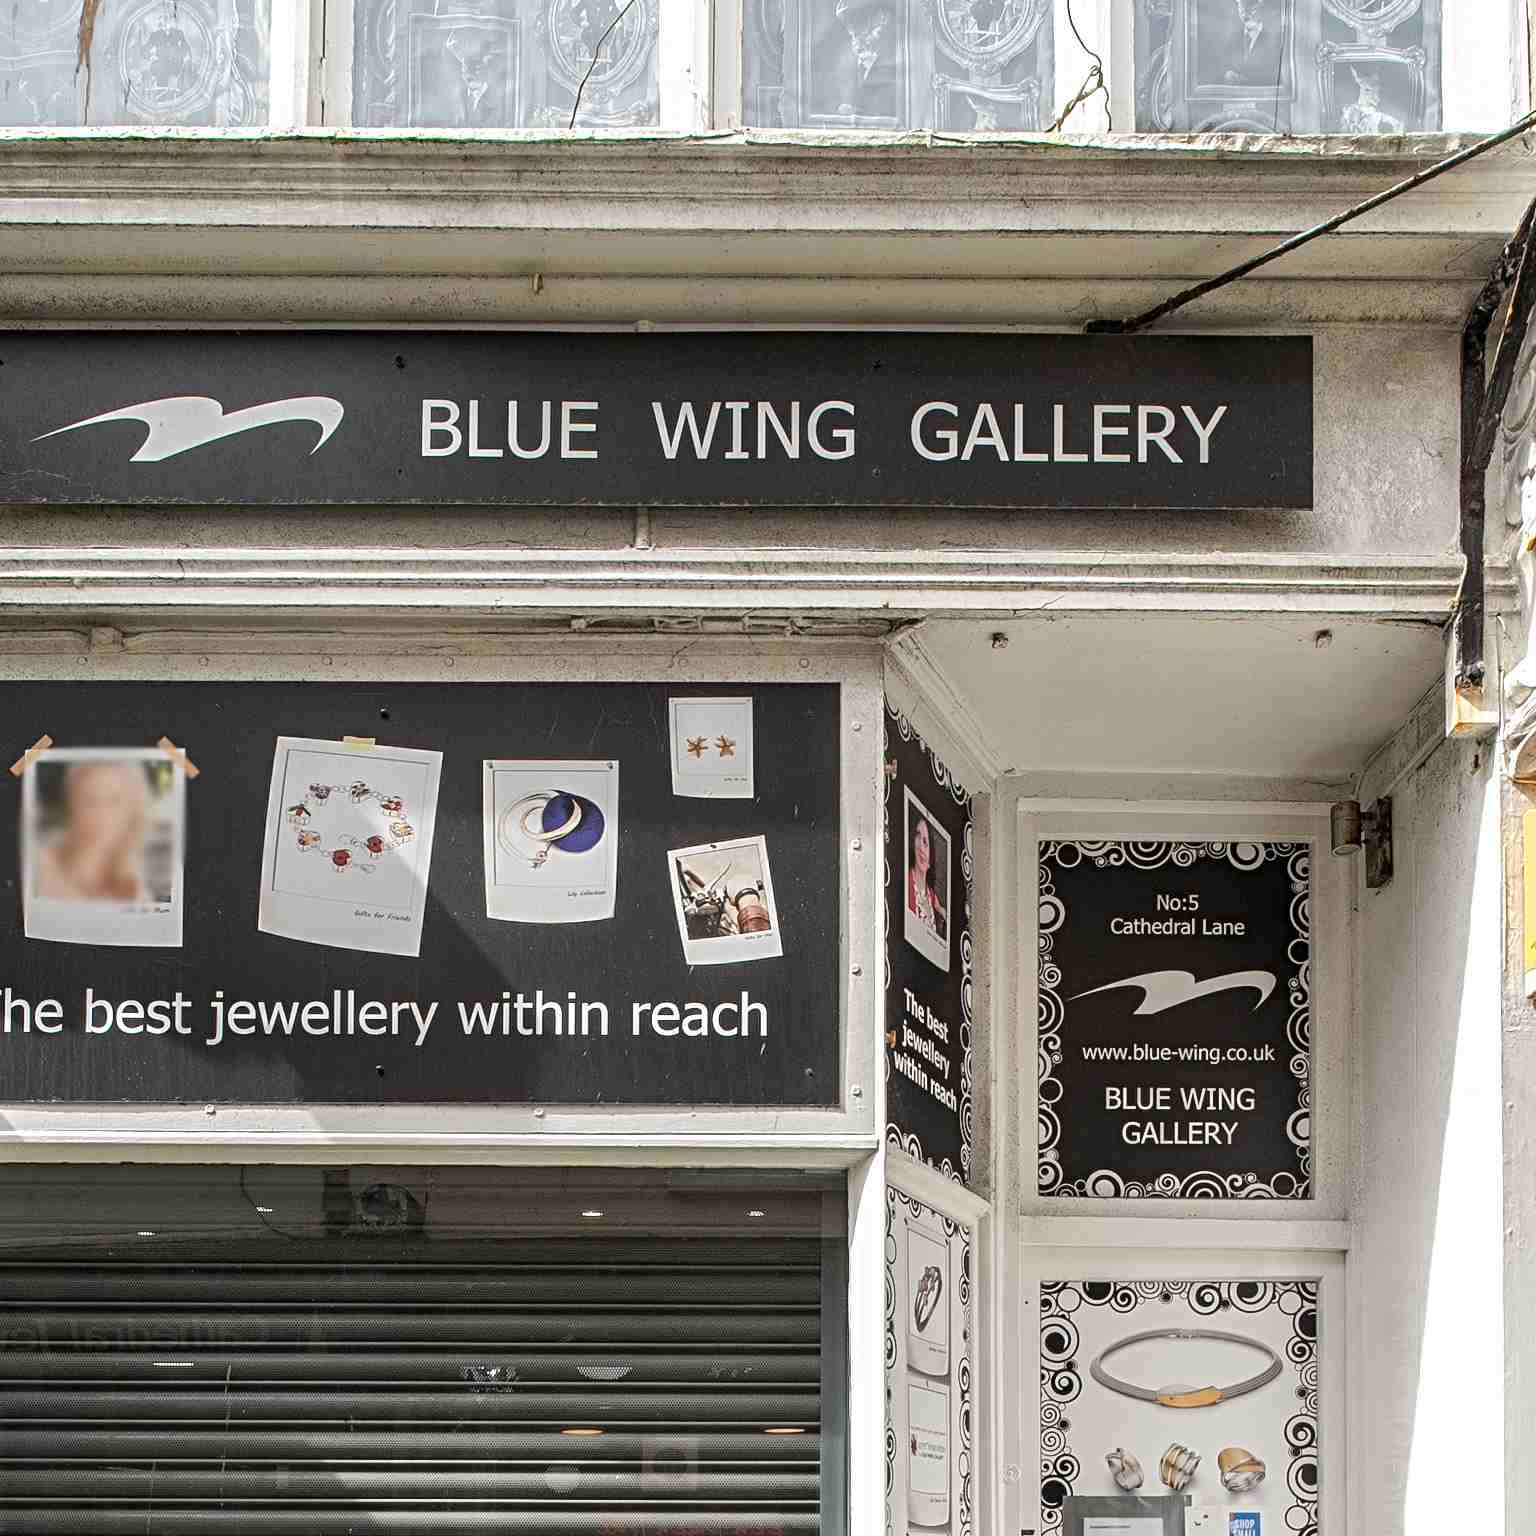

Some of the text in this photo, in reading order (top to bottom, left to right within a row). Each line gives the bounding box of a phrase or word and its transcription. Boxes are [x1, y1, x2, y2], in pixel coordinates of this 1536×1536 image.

[420, 398, 1227, 465] BLUE WING GALLERY
[1156, 894, 1200, 912] No:5
[1110, 918, 1246, 936] Cathedral Lane
[84, 989, 192, 1034] best
[206, 990, 439, 1045] jewellery
[458, 991, 610, 1036] within
[631, 992, 769, 1037] reach
[904, 987, 949, 1044] The best
[902, 1019, 950, 1080] jewellery
[1082, 1043, 1276, 1065] www.blue-wing.co.uk
[894, 1050, 957, 1113] within reach
[1105, 1087, 1256, 1111] BLUE WING
[1121, 1121, 1239, 1145] GALLERY
